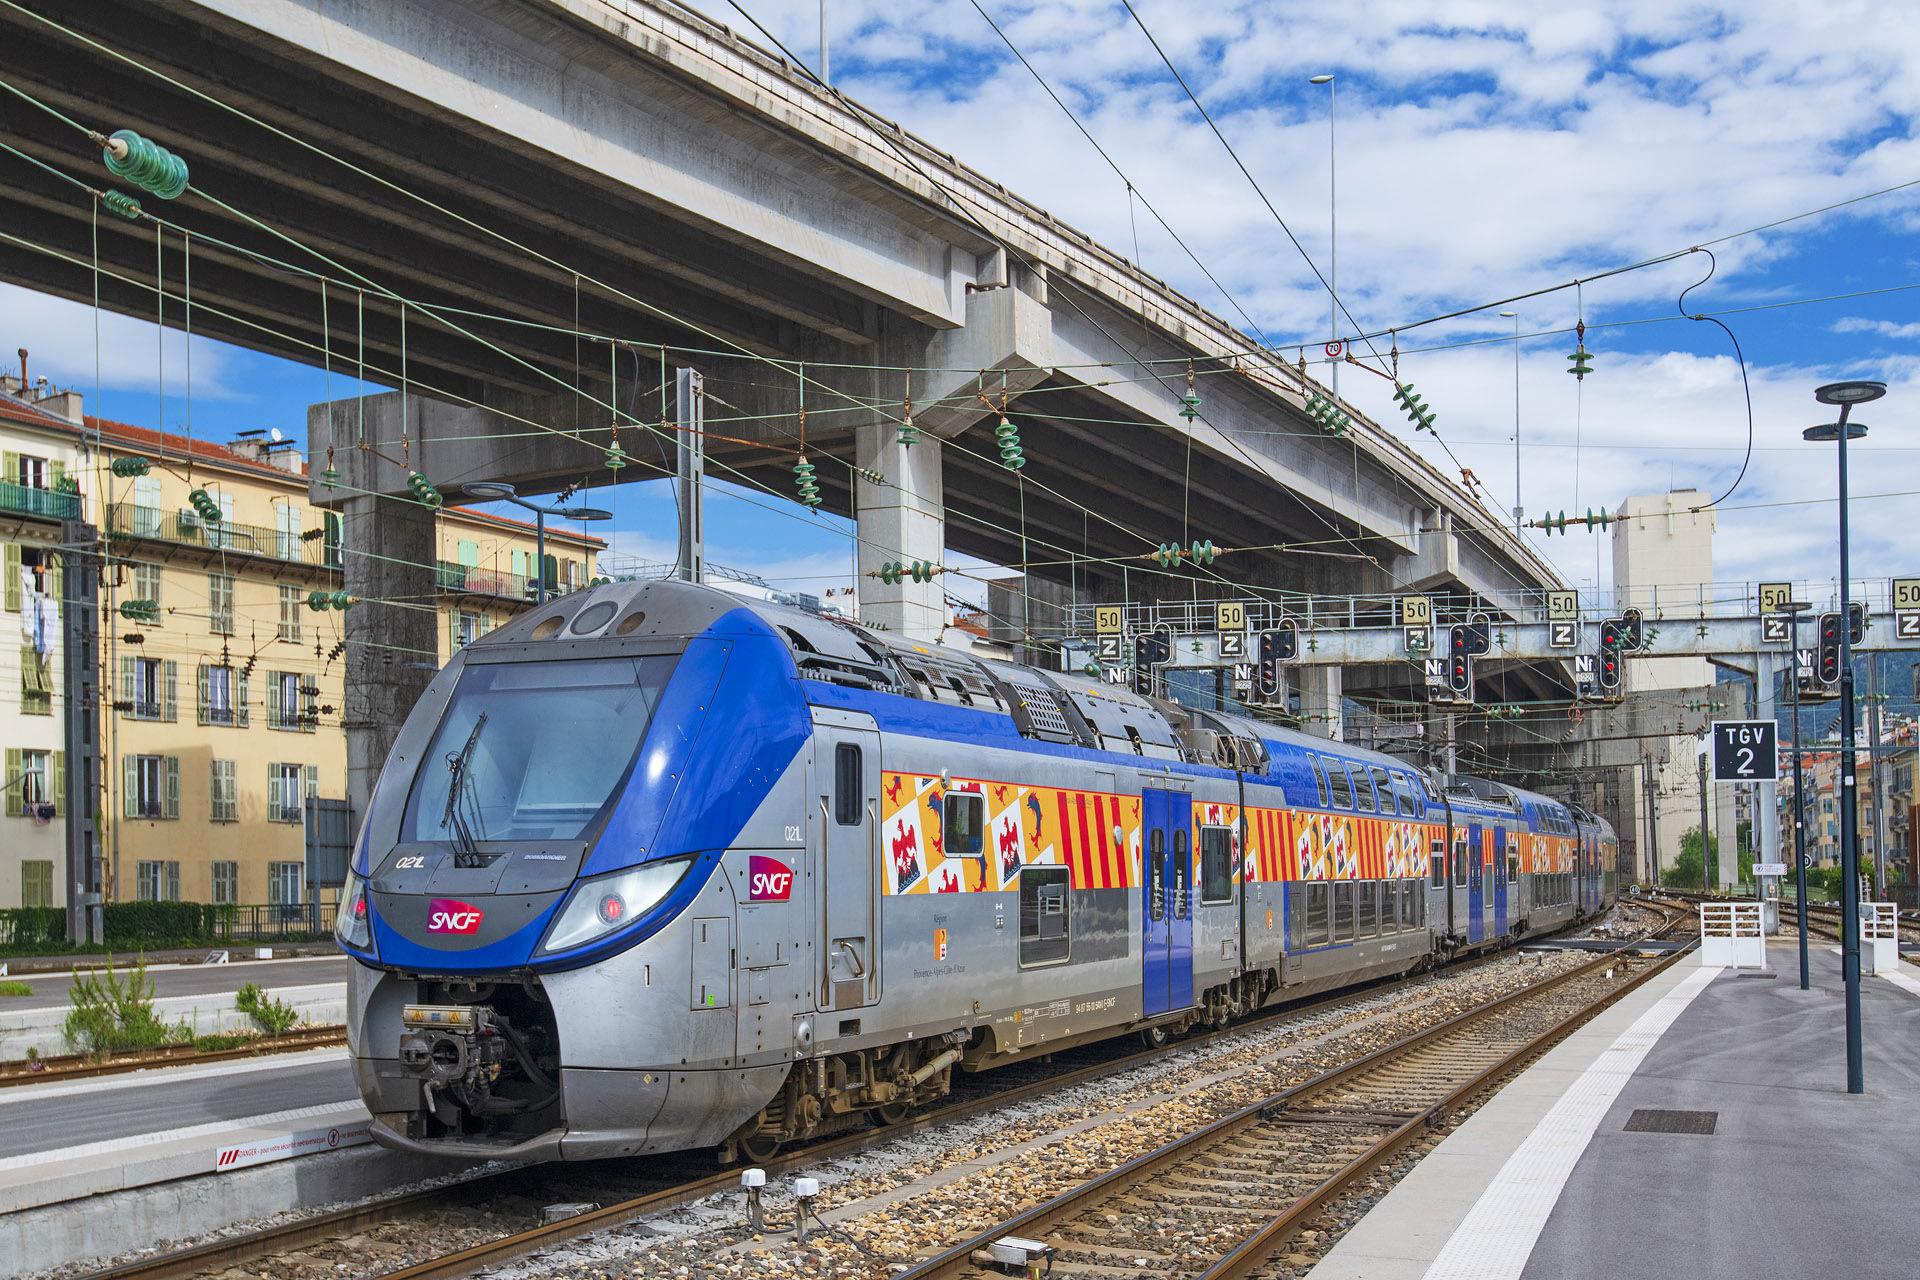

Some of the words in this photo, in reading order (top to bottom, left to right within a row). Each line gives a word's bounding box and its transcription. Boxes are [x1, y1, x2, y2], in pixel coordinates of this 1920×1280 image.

[1329, 344, 1339, 352] 70
[1765, 590, 1786, 606] 50
[1899, 586, 1920, 602] 50
[1407, 602, 1426, 617] 50
[1552, 597, 1572, 612] 50
[1100, 612, 1118, 627] 50
[1222, 608, 1240, 623] 50
[1768, 620, 1784, 636] Z
[1903, 616, 1920, 633] Z
[1555, 626, 1571, 643] Z
[1102, 640, 1117, 655] Z
[1224, 636, 1239, 652] Z
[1426, 659, 1443, 675] Nf
[1575, 655, 1593, 672] Nf
[1109, 668, 1126, 683] Nf
[1235, 664, 1252, 680] Nf
[1725, 727, 1764, 745] TGV
[1736, 747, 1755, 774] 2
[784, 825, 803, 841] 021L
[751, 873, 791, 895] SNCF
[428, 912, 480, 930] SNCF
